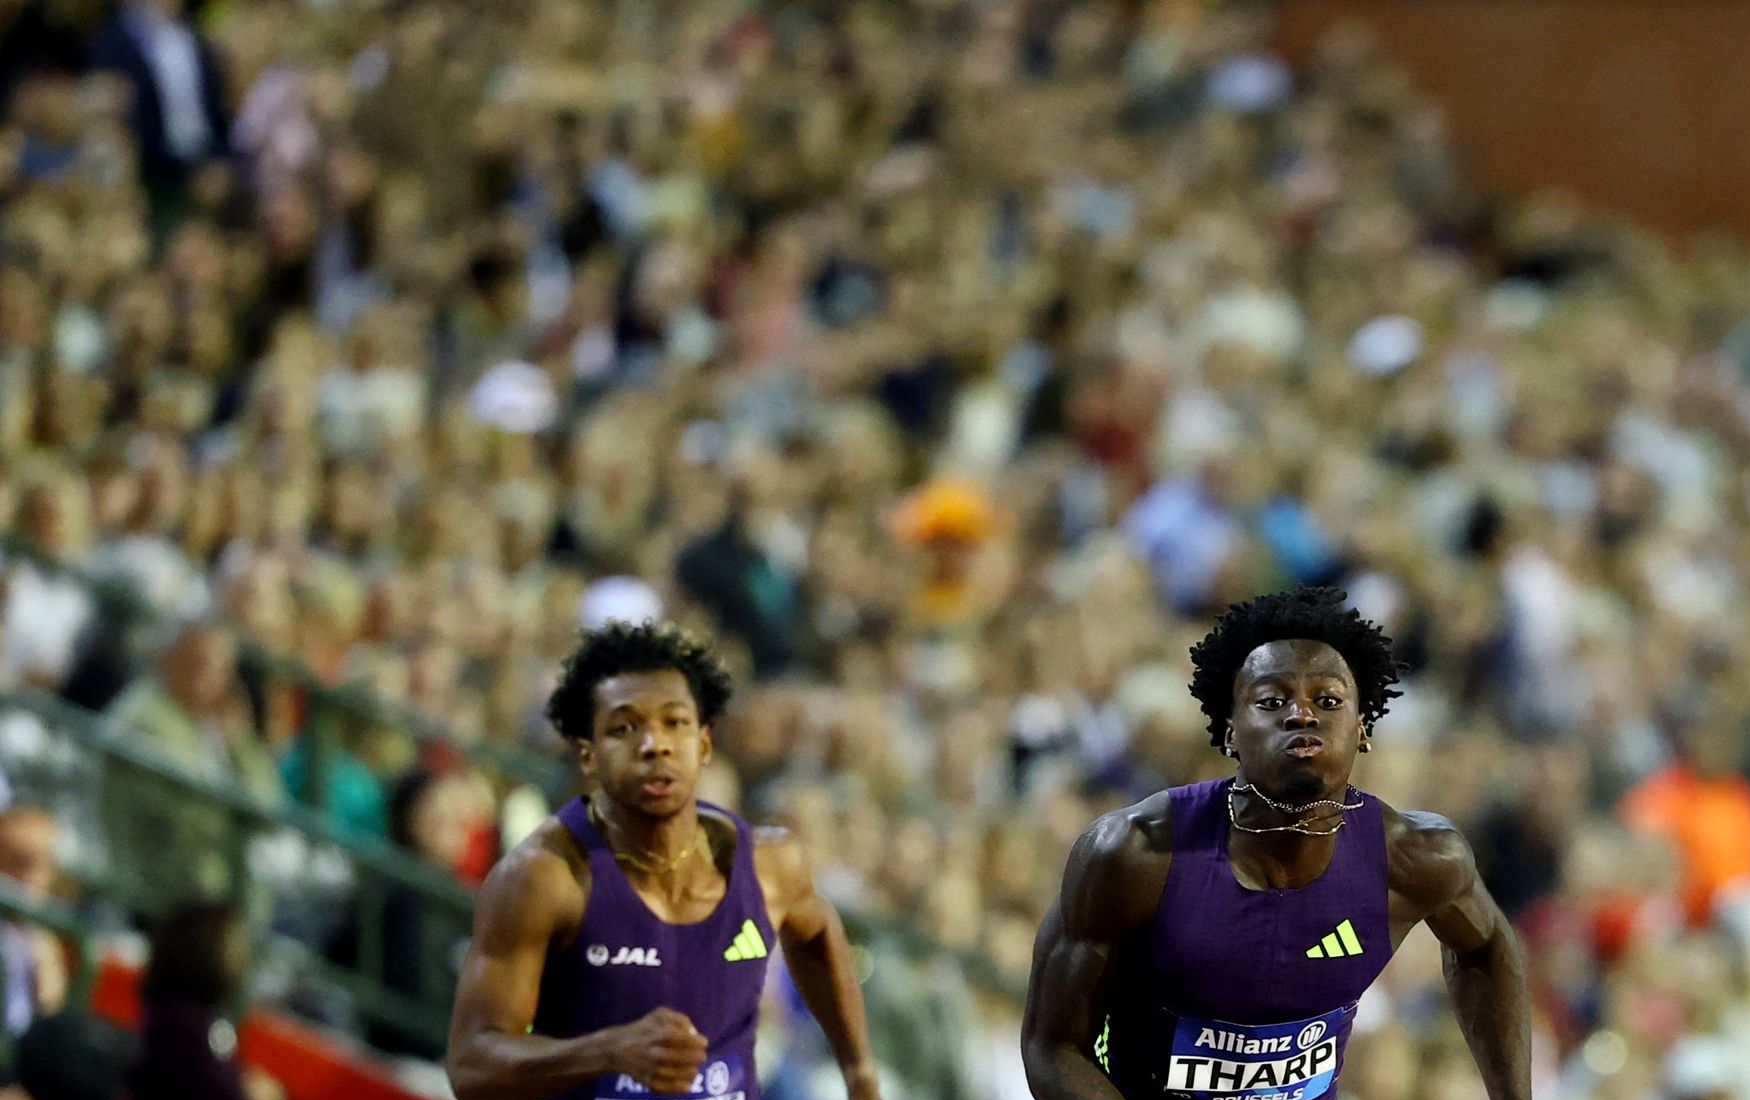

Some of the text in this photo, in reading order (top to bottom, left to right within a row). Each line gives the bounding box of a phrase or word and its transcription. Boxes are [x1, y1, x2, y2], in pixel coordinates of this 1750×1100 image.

[611, 947, 662, 966] JAL
[1194, 1027, 1293, 1054] Allianz
[1176, 1041, 1333, 1090] THARP
